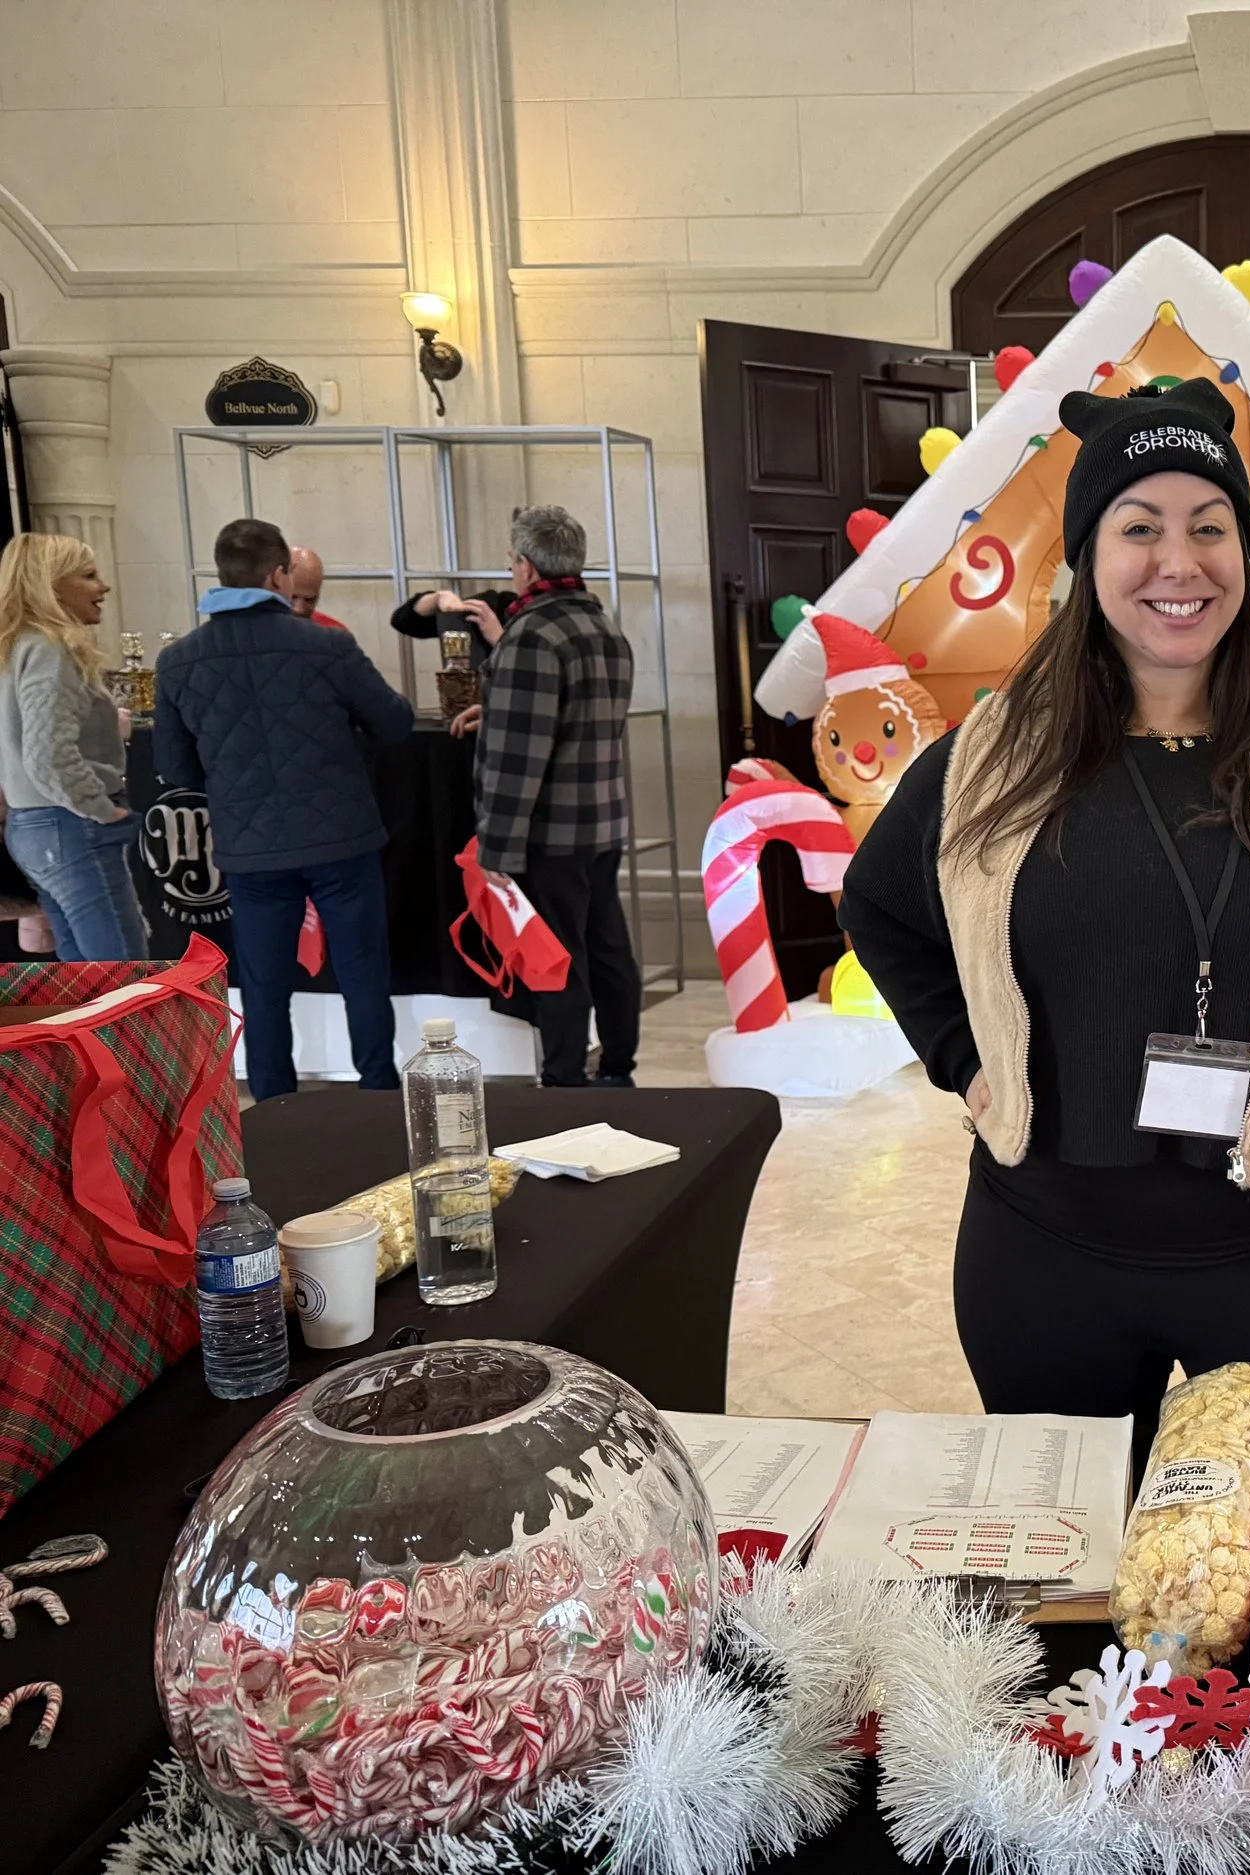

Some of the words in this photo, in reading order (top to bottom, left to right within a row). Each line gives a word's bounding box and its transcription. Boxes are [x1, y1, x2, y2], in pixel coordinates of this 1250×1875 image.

[224, 402, 265, 414] Bellvue
[267, 402, 299, 415] North
[1129, 426, 1214, 445] CELEBRATE
[1123, 435, 1220, 460] TORONTO
